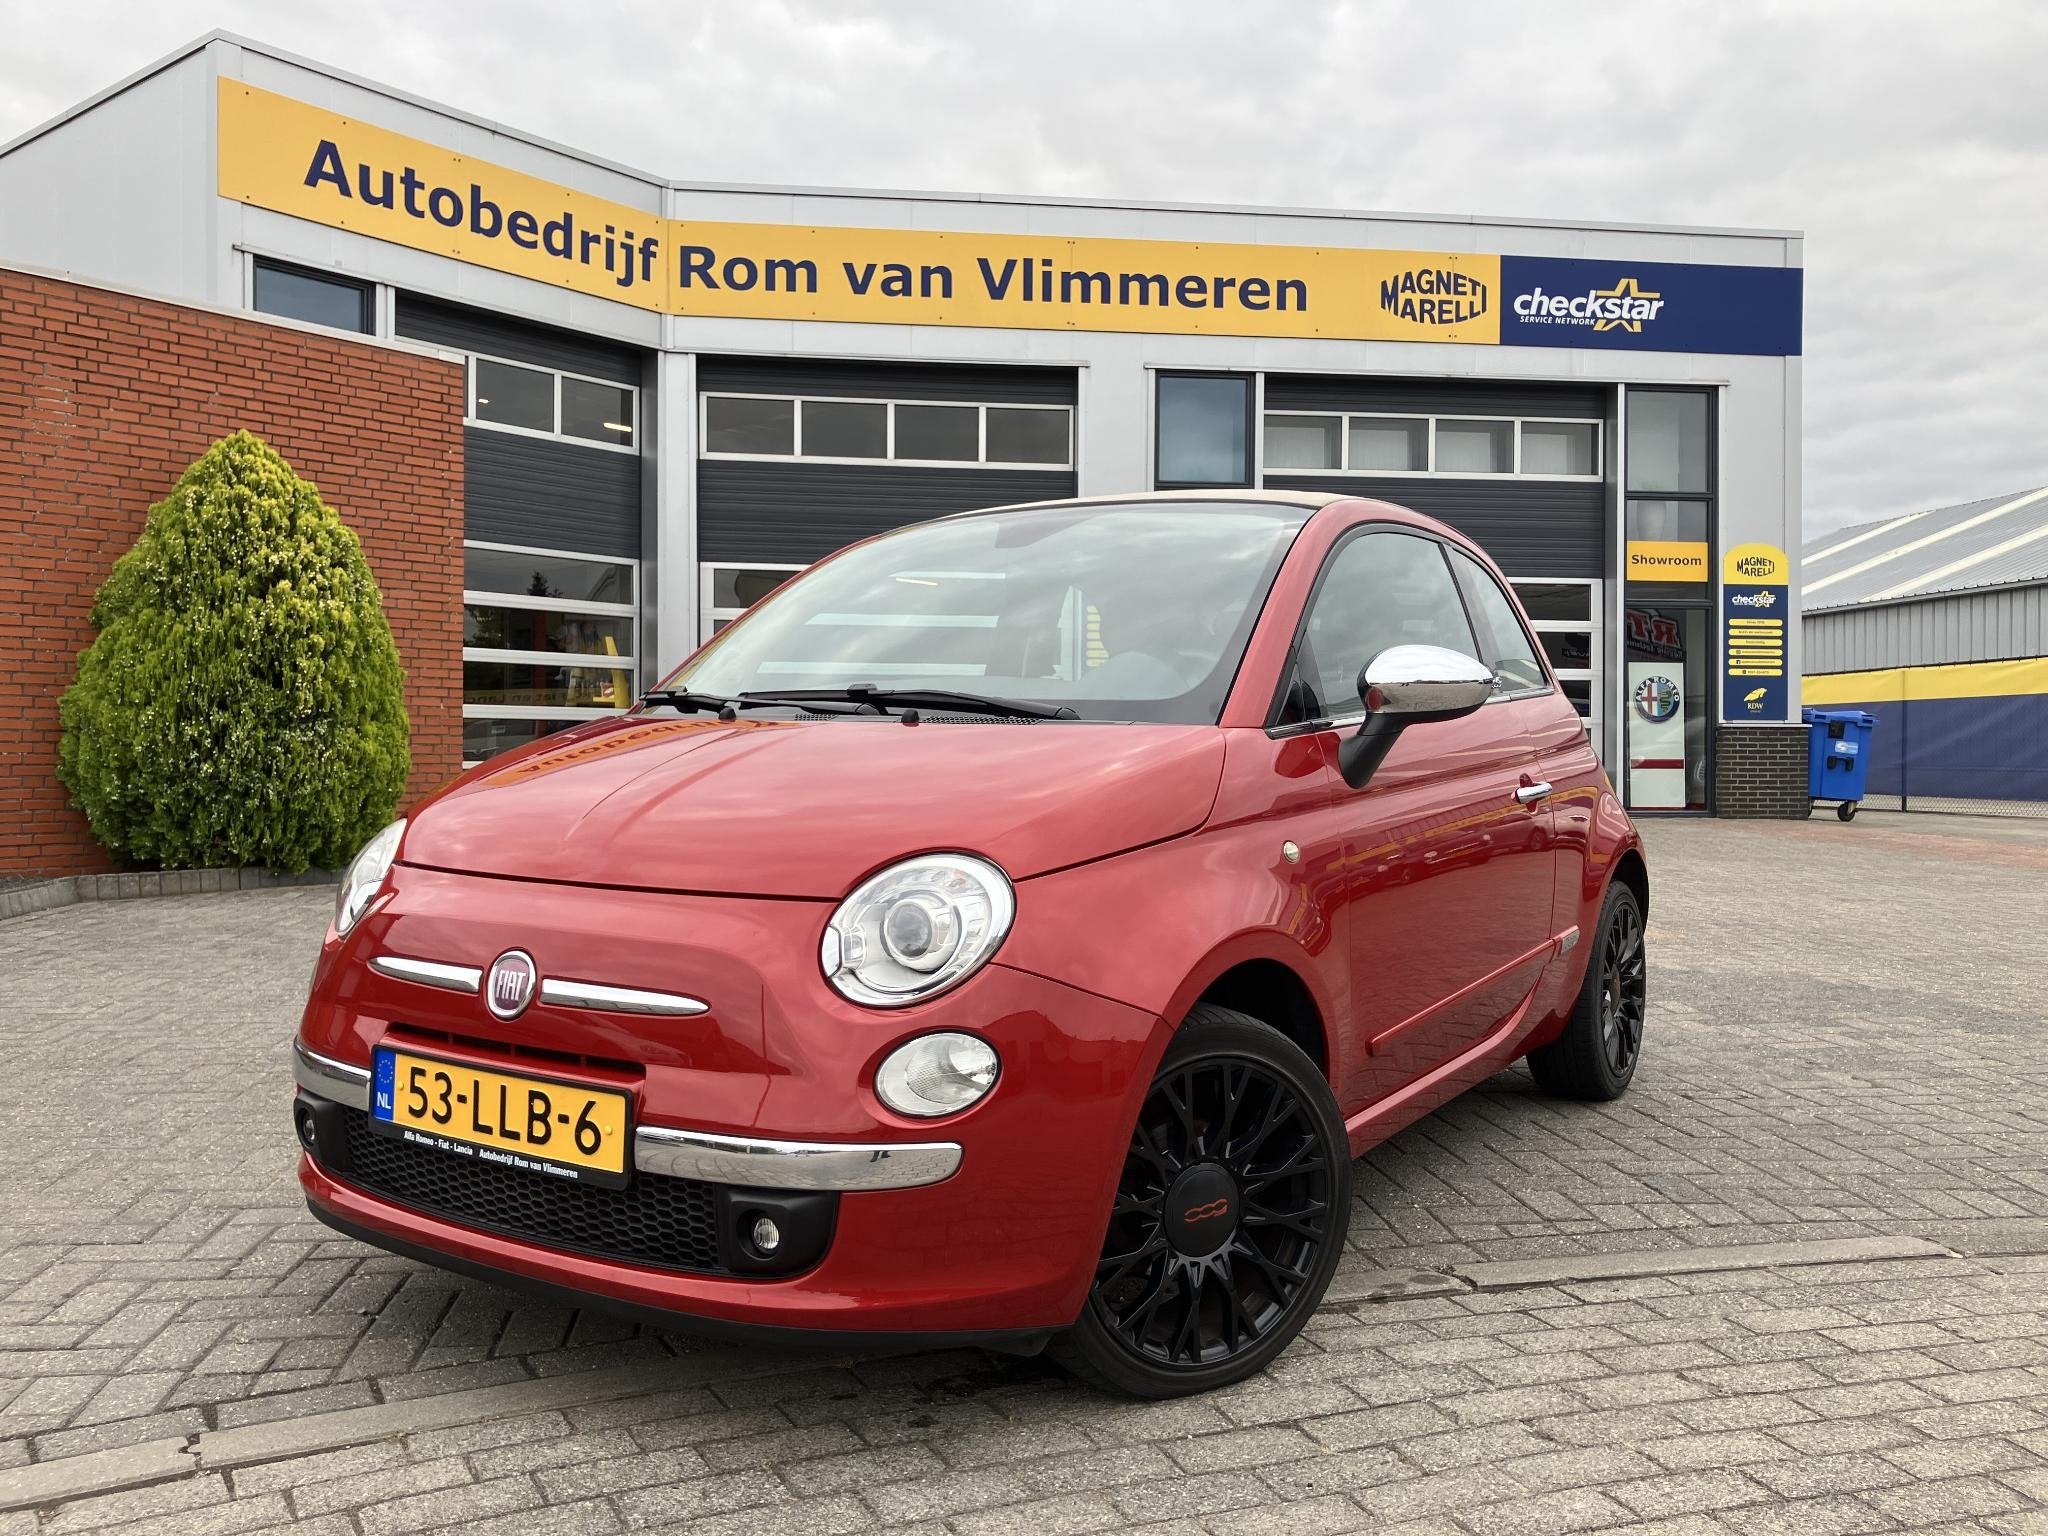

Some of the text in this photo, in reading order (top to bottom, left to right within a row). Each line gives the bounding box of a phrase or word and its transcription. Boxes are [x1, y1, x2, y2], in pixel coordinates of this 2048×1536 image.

[304, 139, 1308, 312] Autobedrijf Rom van Vlimmeren
[1513, 287, 1665, 321] checkstar
[1519, 316, 1596, 326] SERVICE NETWORK
[1631, 554, 1702, 566] Showroom
[1732, 594, 1777, 605] checkstar
[1635, 676, 1680, 702] ALFA ROMEO
[496, 970, 527, 1002] FIAT
[377, 1091, 391, 1110] NL
[407, 1066, 602, 1156] 53-LLB-6
[403, 1130, 415, 1141] Alfa
[415, 1133, 434, 1146] Romeo
[438, 1139, 450, 1150] Fiat
[454, 1142, 473, 1156] Lancia
[479, 1149, 513, 1166] Autobedrijf
[514, 1156, 529, 1169] Rom
[530, 1161, 542, 1171] van
[543, 1162, 578, 1179] Vlimmeren
